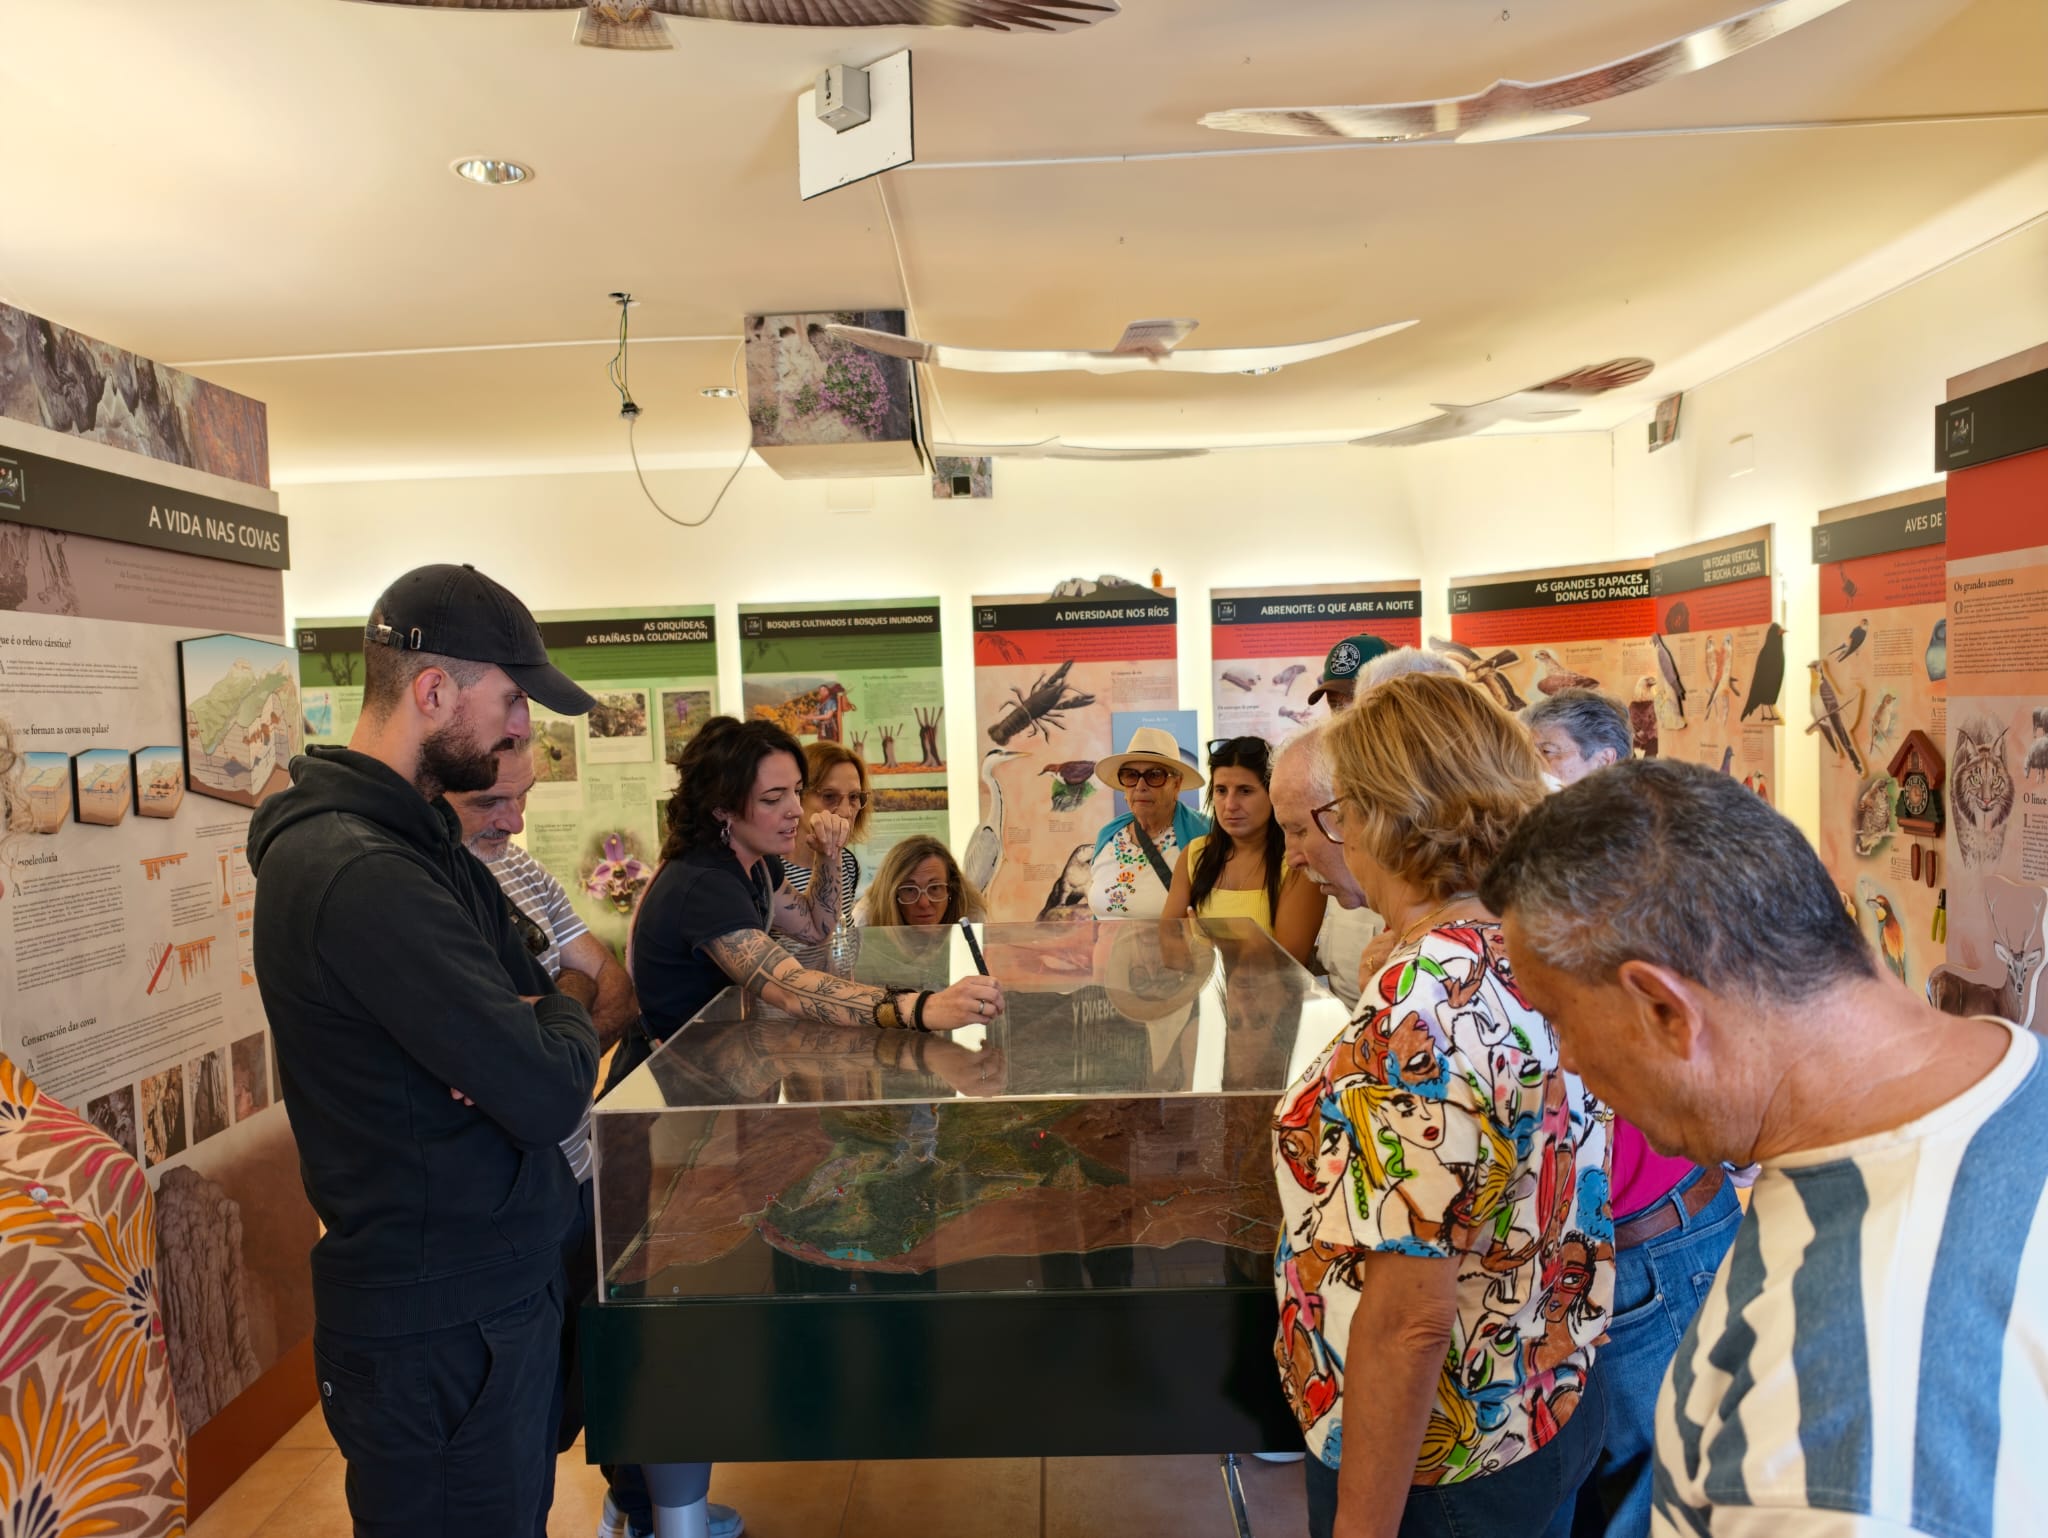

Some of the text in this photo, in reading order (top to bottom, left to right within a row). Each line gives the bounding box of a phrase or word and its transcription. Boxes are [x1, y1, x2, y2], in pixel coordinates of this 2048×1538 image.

[149, 505, 281, 553] A VIDA NAS COVAS
[1904, 512, 1943, 533] AVES DE
[1731, 547, 1760, 565] VERTICAL
[1703, 571, 1712, 583] DE
[1731, 561, 1761, 577] CALCARIA
[1535, 582, 1549, 593] AS
[1550, 578, 1596, 592] GRANDES
[1555, 583, 1650, 603] DONAS DO PARQUE
[1953, 581, 1963, 592] Os
[1963, 577, 1987, 594] grandes
[1055, 605, 1170, 622] A DIVERSIDADE NOS RÍOS
[1260, 600, 1414, 616] ABRENOITE: O QUE ABRE A NOITE
[643, 621, 656, 631] AS
[766, 614, 934, 630] BOSQUES CULTIVADOS E BOSQUES INUNDADOS
[22, 634, 43, 647] relevo
[585, 634, 599, 645] AS
[632, 633, 646, 643] DA
[30, 723, 56, 736] forman
[64, 726, 82, 735] covas
[2023, 792, 2048, 806] O lince
